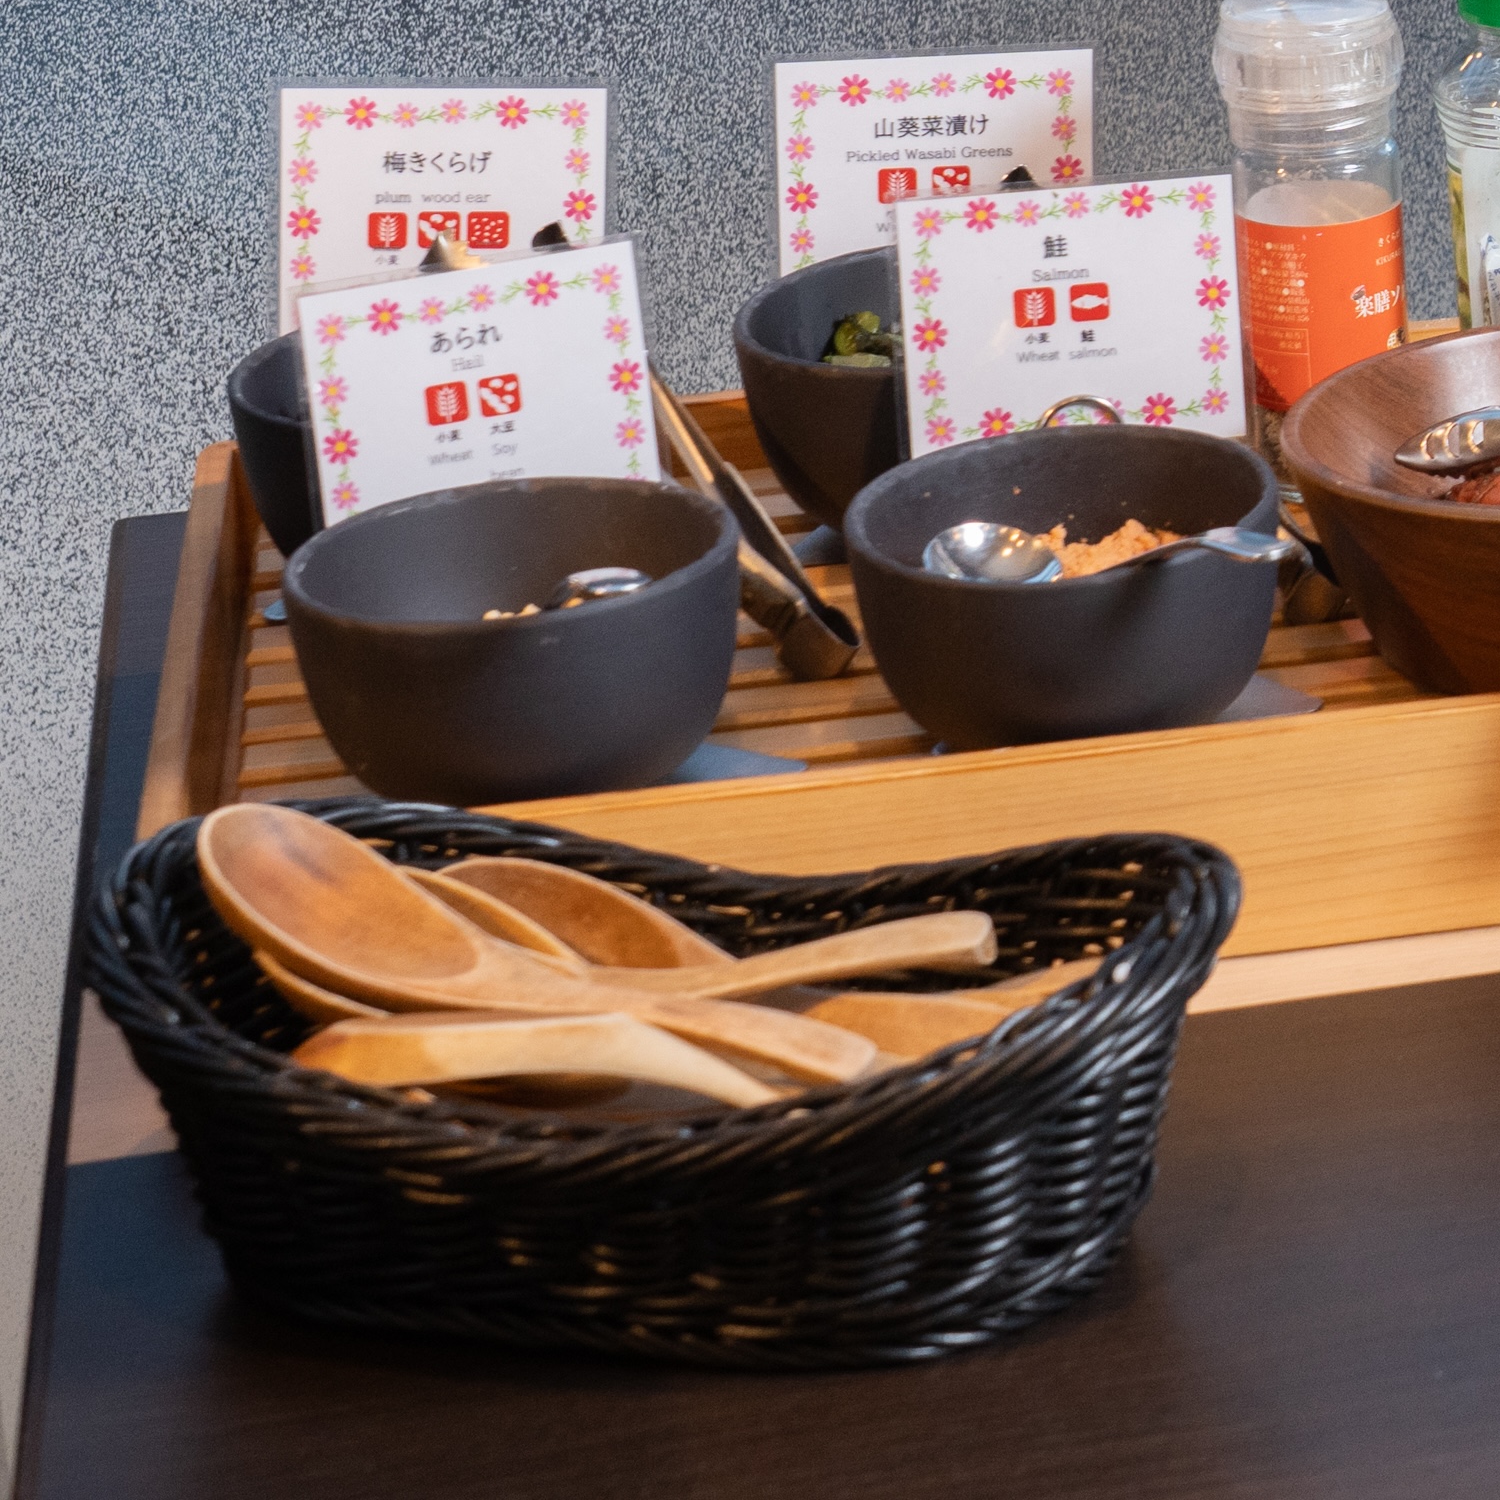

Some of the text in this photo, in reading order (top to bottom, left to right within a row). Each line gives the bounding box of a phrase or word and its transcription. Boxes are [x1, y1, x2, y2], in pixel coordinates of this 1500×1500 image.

[874, 113, 990, 139] 山葵菜漬け
[382, 150, 493, 174] 梅きくらげ
[846, 146, 1013, 163] Pickled Wasabi Greens
[374, 190, 491, 204] plum wood ear
[1043, 235, 1068, 259] 鮭
[1032, 267, 1090, 283] Salmon
[430, 323, 504, 353] あられ
